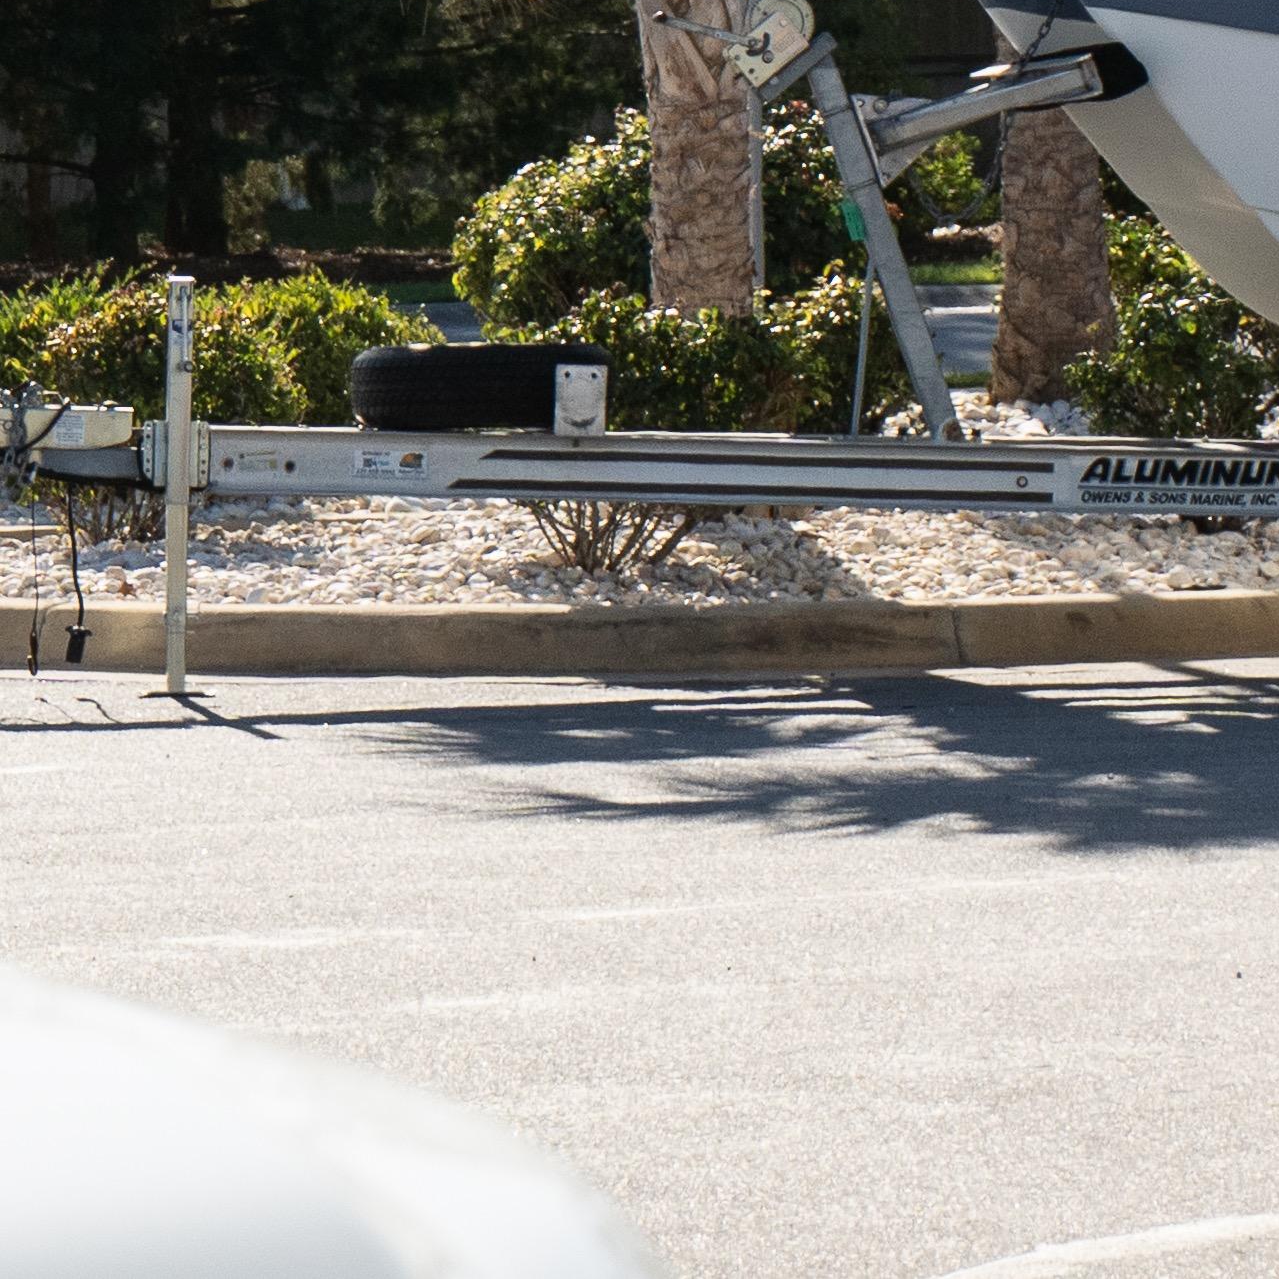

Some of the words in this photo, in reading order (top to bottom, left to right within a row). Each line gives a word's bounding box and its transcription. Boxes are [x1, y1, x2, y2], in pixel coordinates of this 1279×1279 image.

[1081, 490, 1130, 504] OWENS
[1134, 490, 1145, 503] &
[1150, 492, 1188, 505] SONS
[1190, 493, 1247, 508] MARINE,
[1251, 494, 1277, 507] INC.
